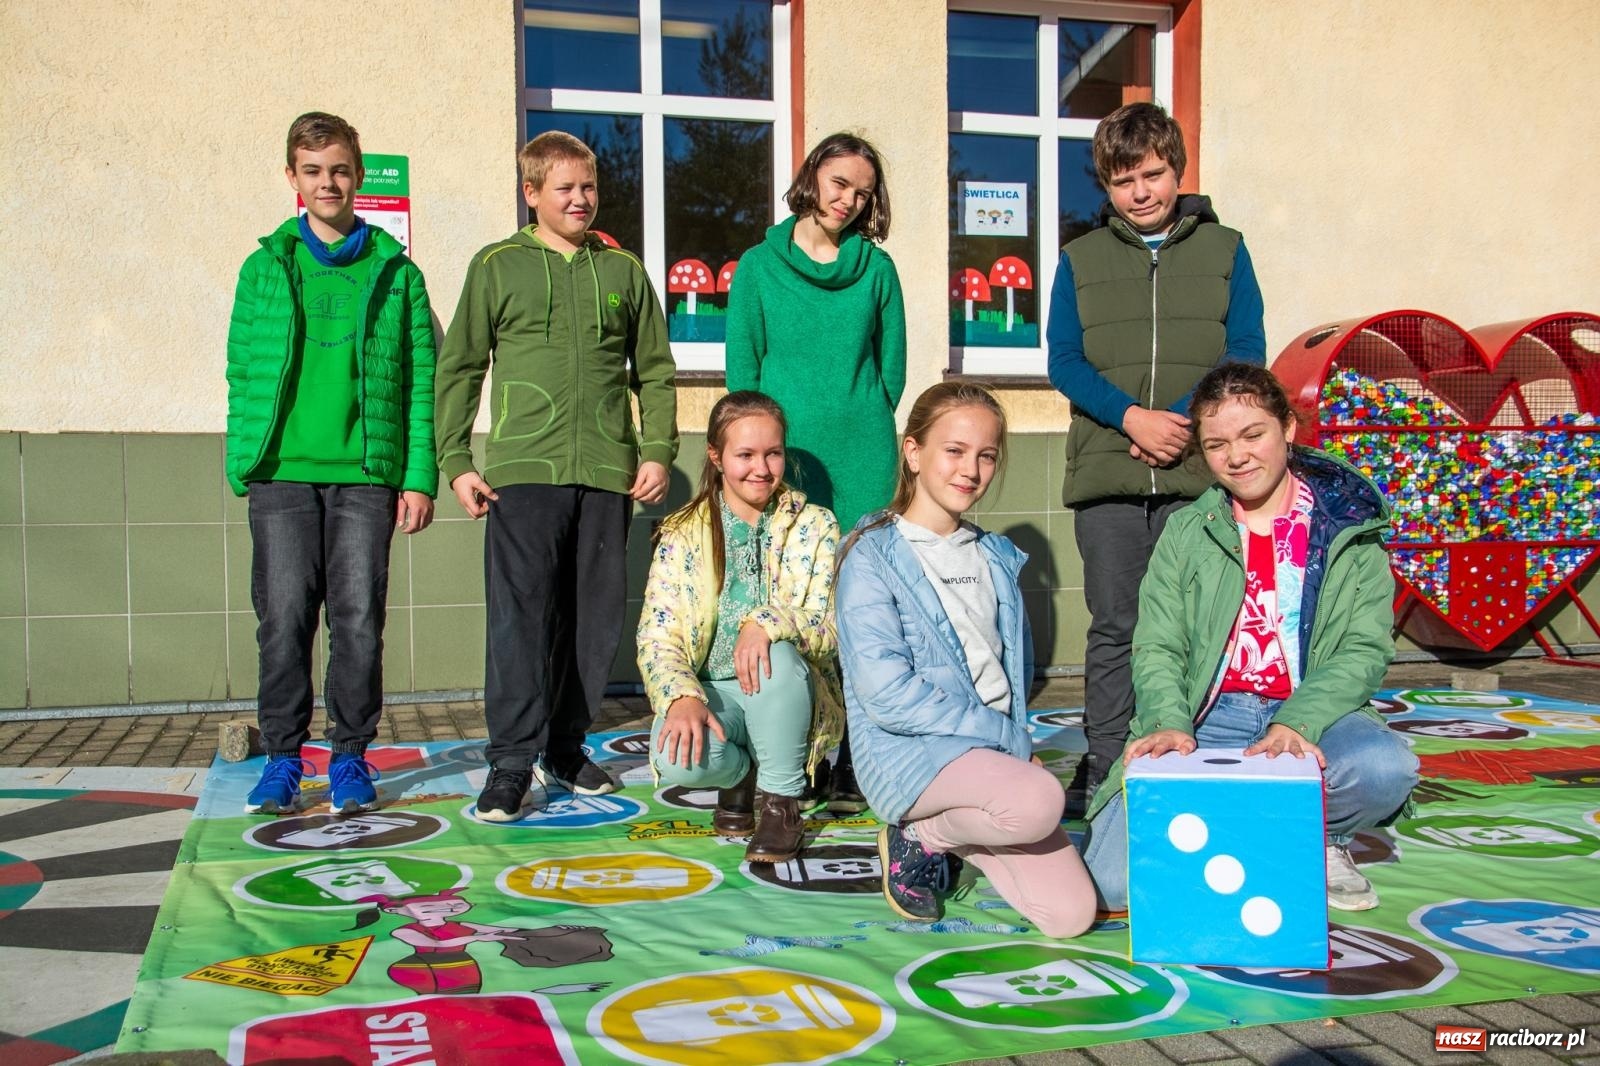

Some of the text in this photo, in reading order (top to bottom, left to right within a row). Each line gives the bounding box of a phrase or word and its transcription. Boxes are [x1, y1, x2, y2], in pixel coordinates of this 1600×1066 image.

[365, 167, 399, 176] lator AED
[310, 270, 358, 285] TOGETHER
[387, 287, 404, 296] 4F
[307, 291, 352, 315] 4F
[627, 820, 704, 833] XL
[197, 969, 236, 981] NIE
